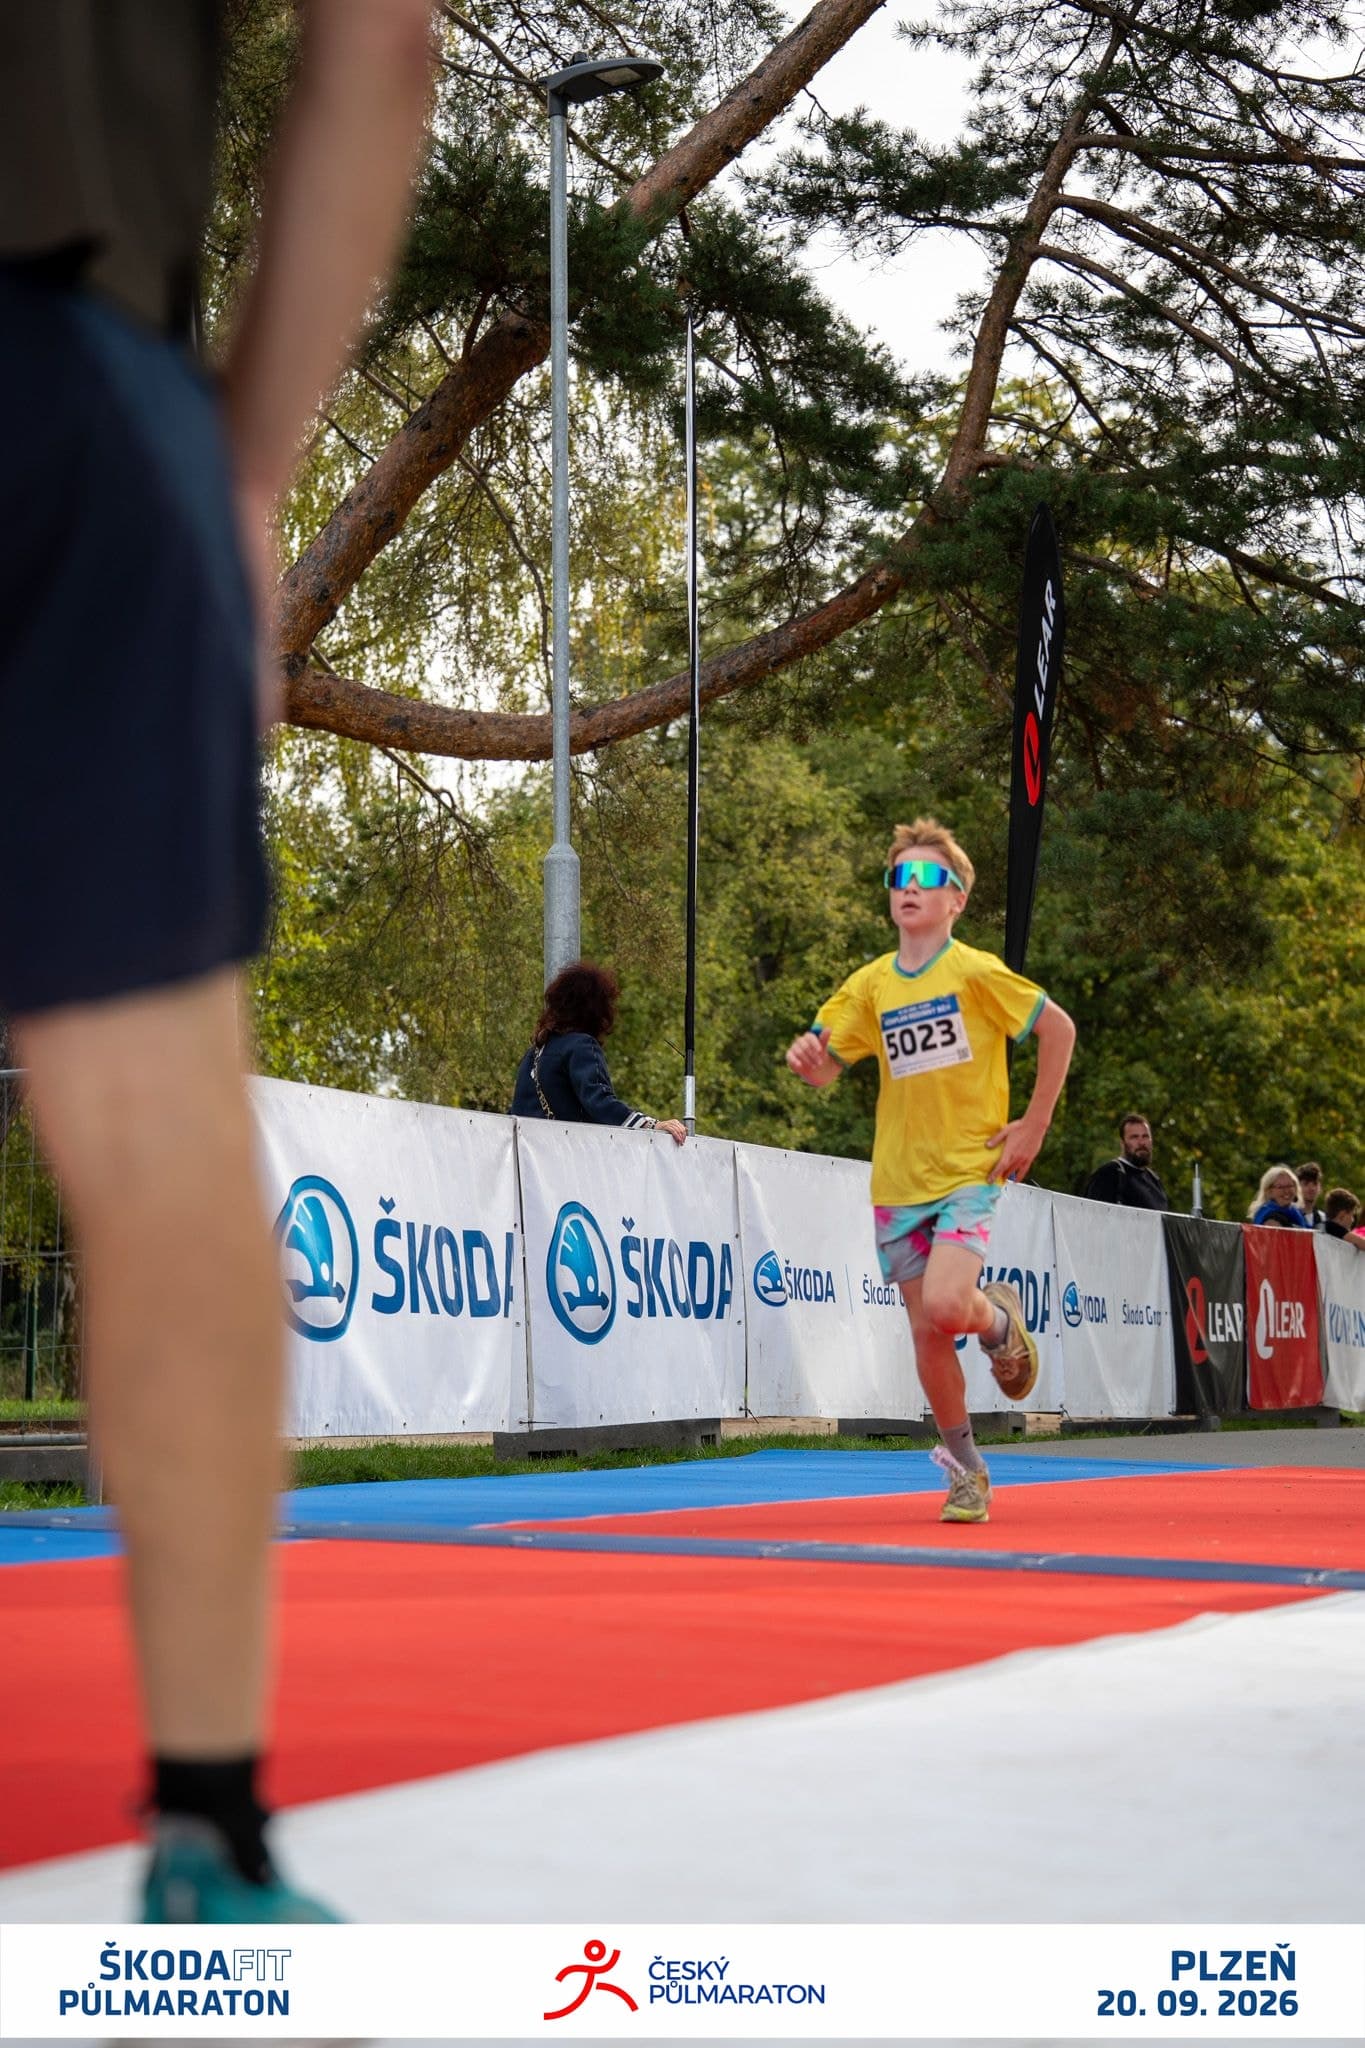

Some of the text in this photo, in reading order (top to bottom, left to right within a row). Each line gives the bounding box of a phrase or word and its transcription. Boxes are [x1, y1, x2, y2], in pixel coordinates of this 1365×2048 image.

[1034, 579, 1057, 721] LEAR
[886, 1018, 957, 1061] 5023
[620, 1215, 733, 1320] ŠKODA
[784, 1259, 836, 1303] ŠKODA
[1275, 1301, 1306, 1339] LEAR
